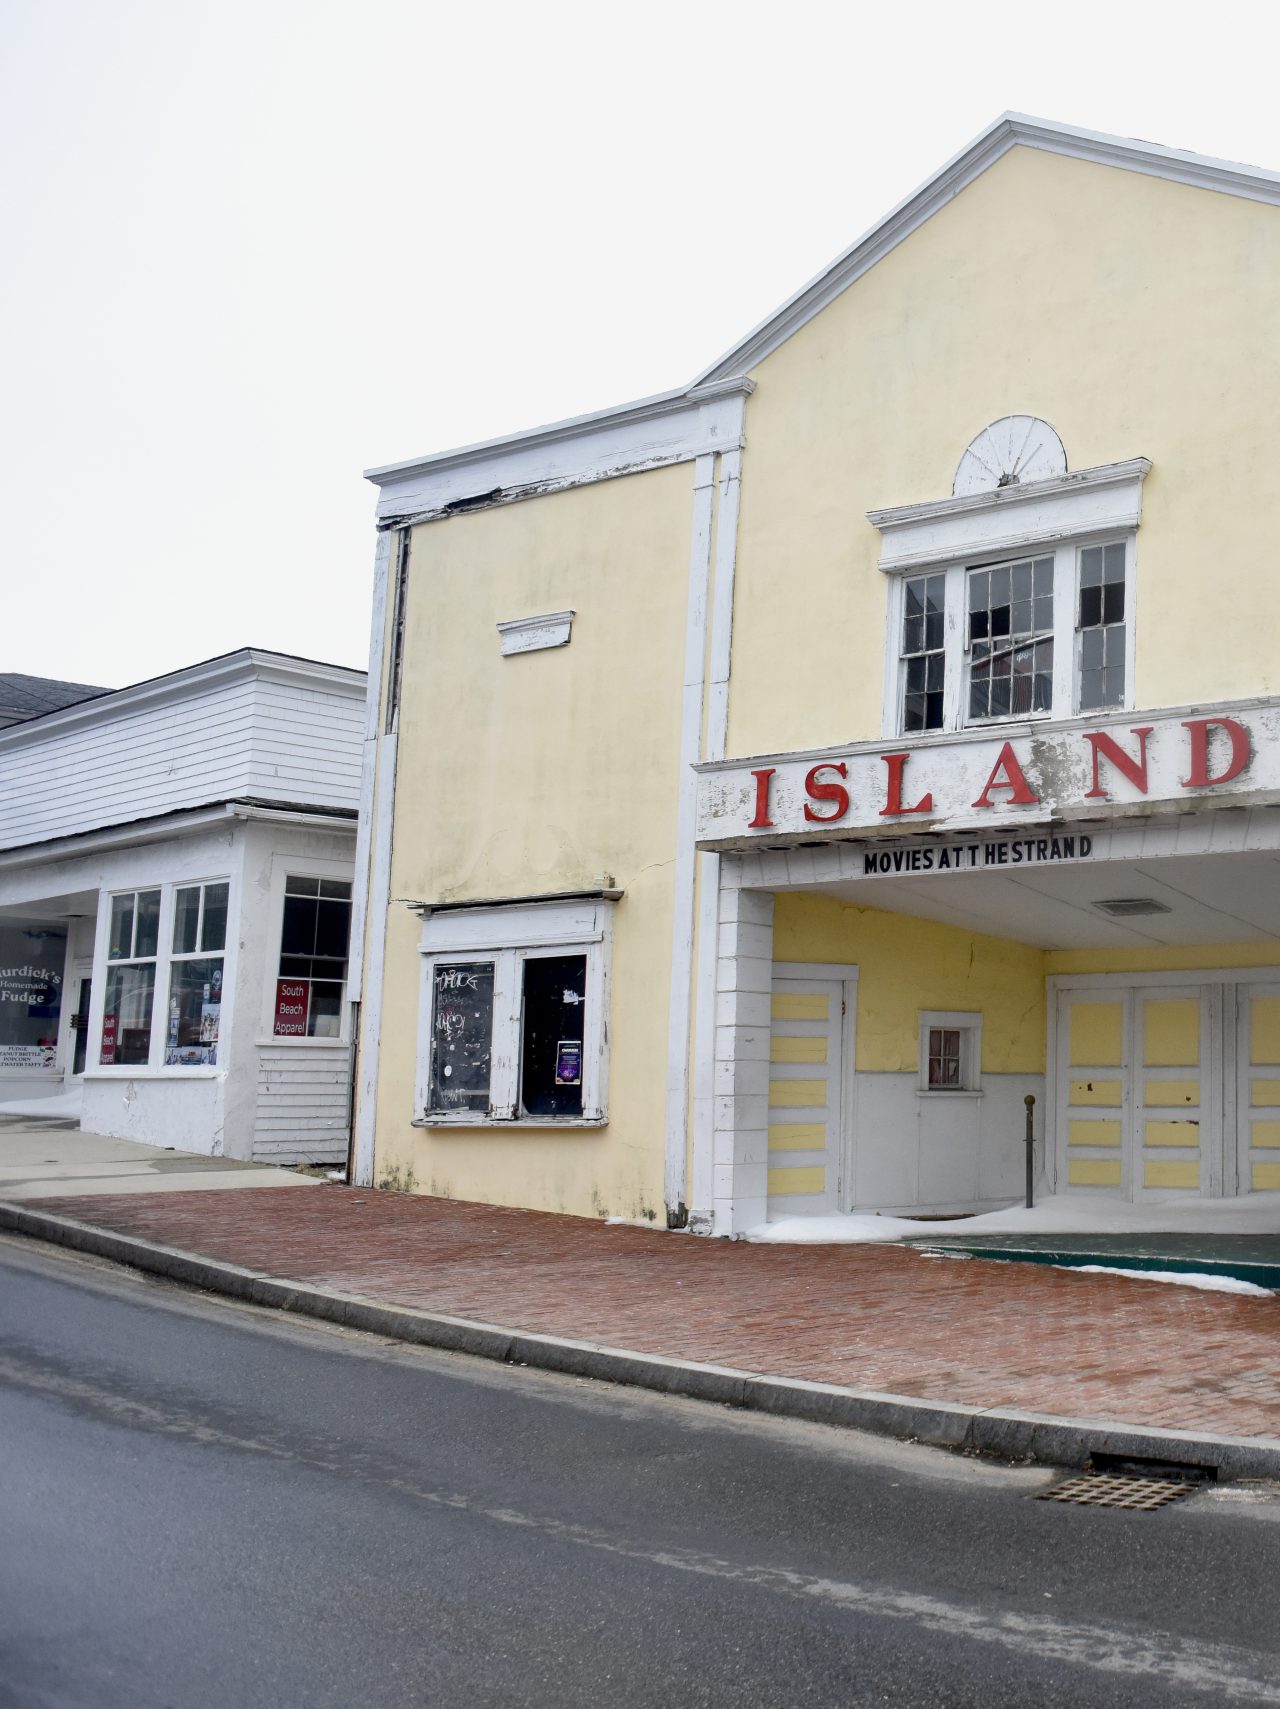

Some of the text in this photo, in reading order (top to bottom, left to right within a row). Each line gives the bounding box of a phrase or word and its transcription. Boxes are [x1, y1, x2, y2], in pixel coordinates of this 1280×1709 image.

[748, 717, 1252, 829] ISLAND
[865, 848, 934, 874] MOVIES
[1012, 836, 1092, 862] STRAND
[0, 980, 48, 990] Homemade
[281, 984, 304, 996] South
[1, 990, 45, 1005] Fudge
[280, 1002, 303, 1015] Beach
[275, 1020, 305, 1035] Apparel
